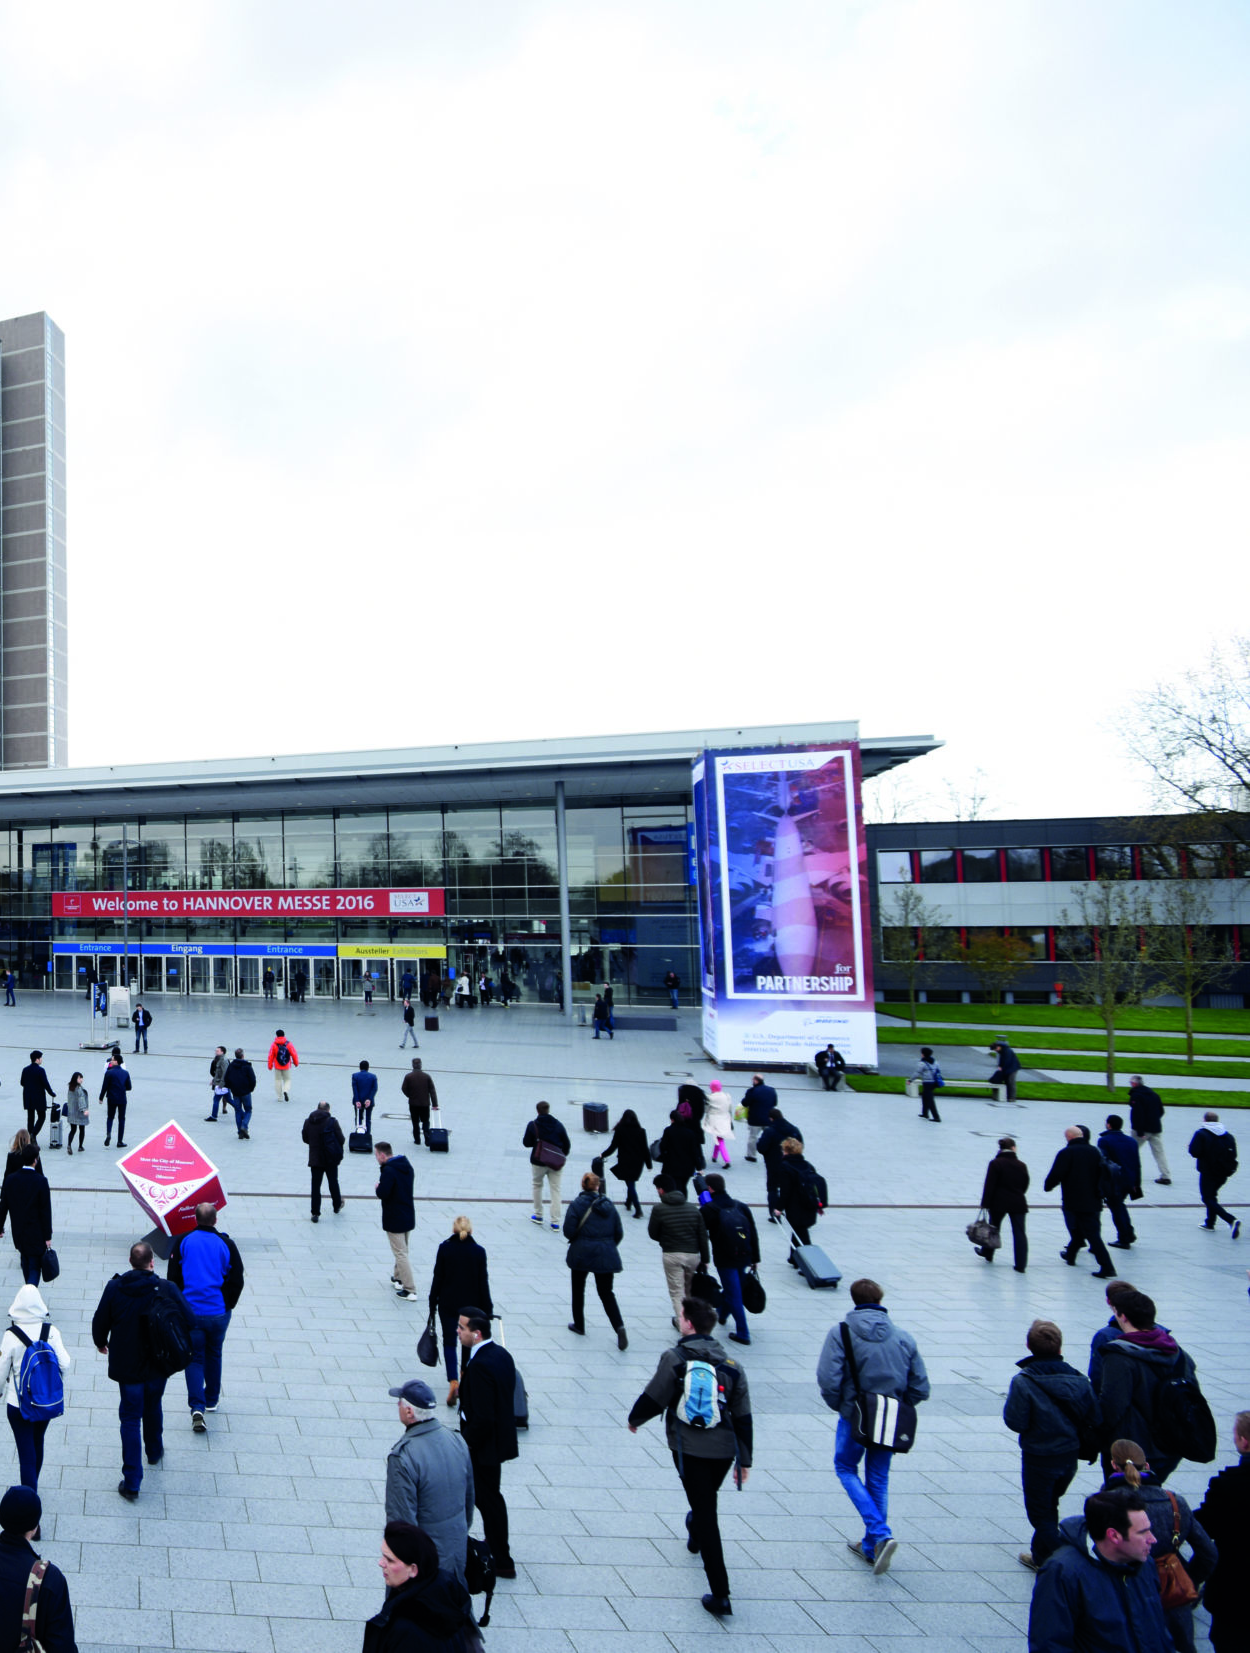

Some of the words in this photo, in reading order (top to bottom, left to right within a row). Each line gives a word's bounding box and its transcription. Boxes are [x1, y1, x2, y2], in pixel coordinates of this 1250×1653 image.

[92, 897, 158, 911] Welcome
[163, 898, 178, 911] to
[183, 896, 273, 911] HANNOVER
[278, 895, 331, 910] MESSE
[335, 895, 375, 910] 2016
[394, 899, 414, 907] USA
[79, 943, 112, 952] Entrance
[171, 944, 203, 954] Eingang
[267, 945, 303, 954] Entrance
[355, 946, 389, 955] Aussteller
[834, 963, 852, 975] for
[756, 975, 854, 992] PARTNERSHIP
